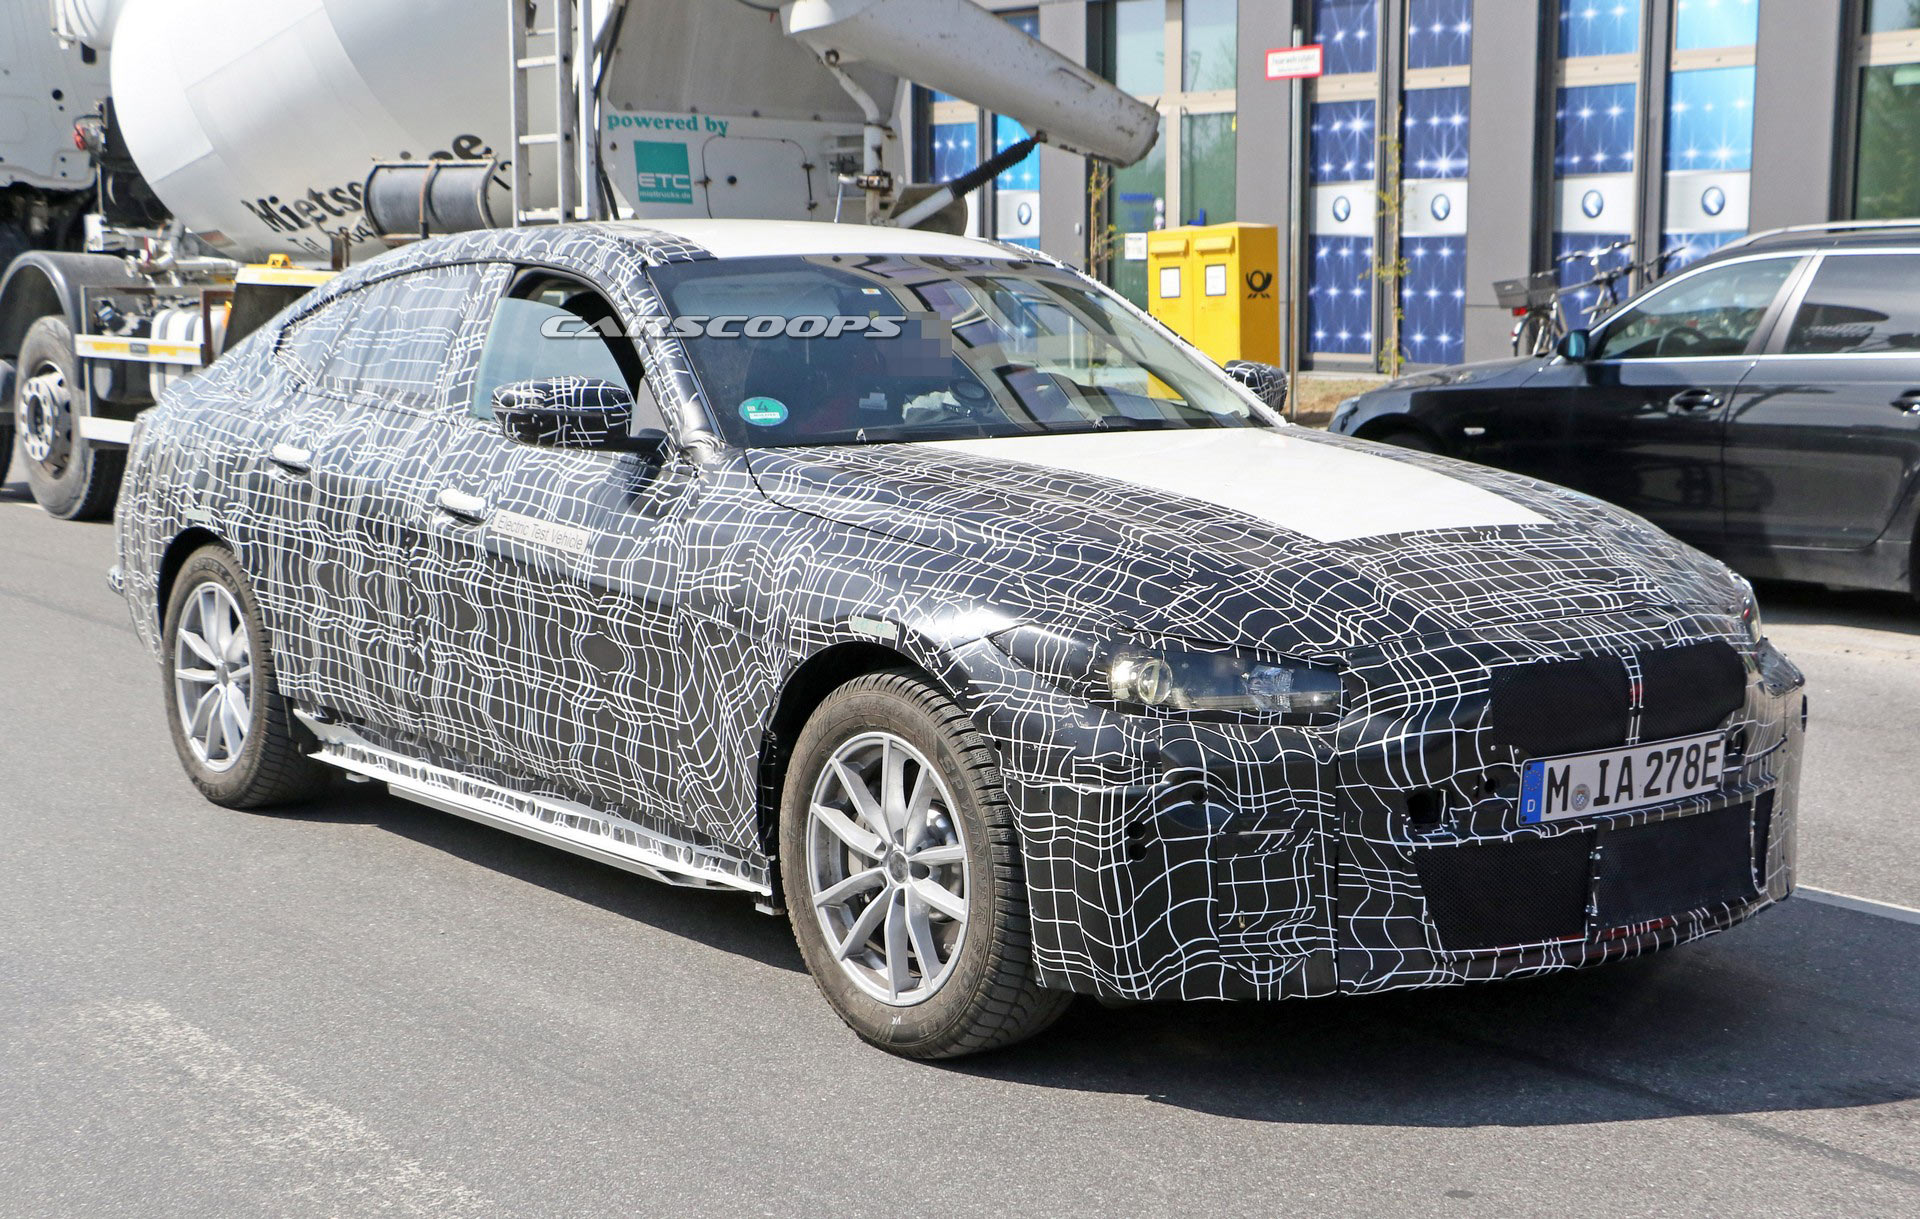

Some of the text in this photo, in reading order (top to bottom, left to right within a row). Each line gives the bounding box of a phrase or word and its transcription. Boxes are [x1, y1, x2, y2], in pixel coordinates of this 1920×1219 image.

[606, 114, 728, 136] powered by
[638, 173, 690, 188] ETC
[757, 400, 768, 412] 4
[498, 515, 583, 549] Electric Test Vehicle
[1527, 740, 1721, 814] D M IA 278E
